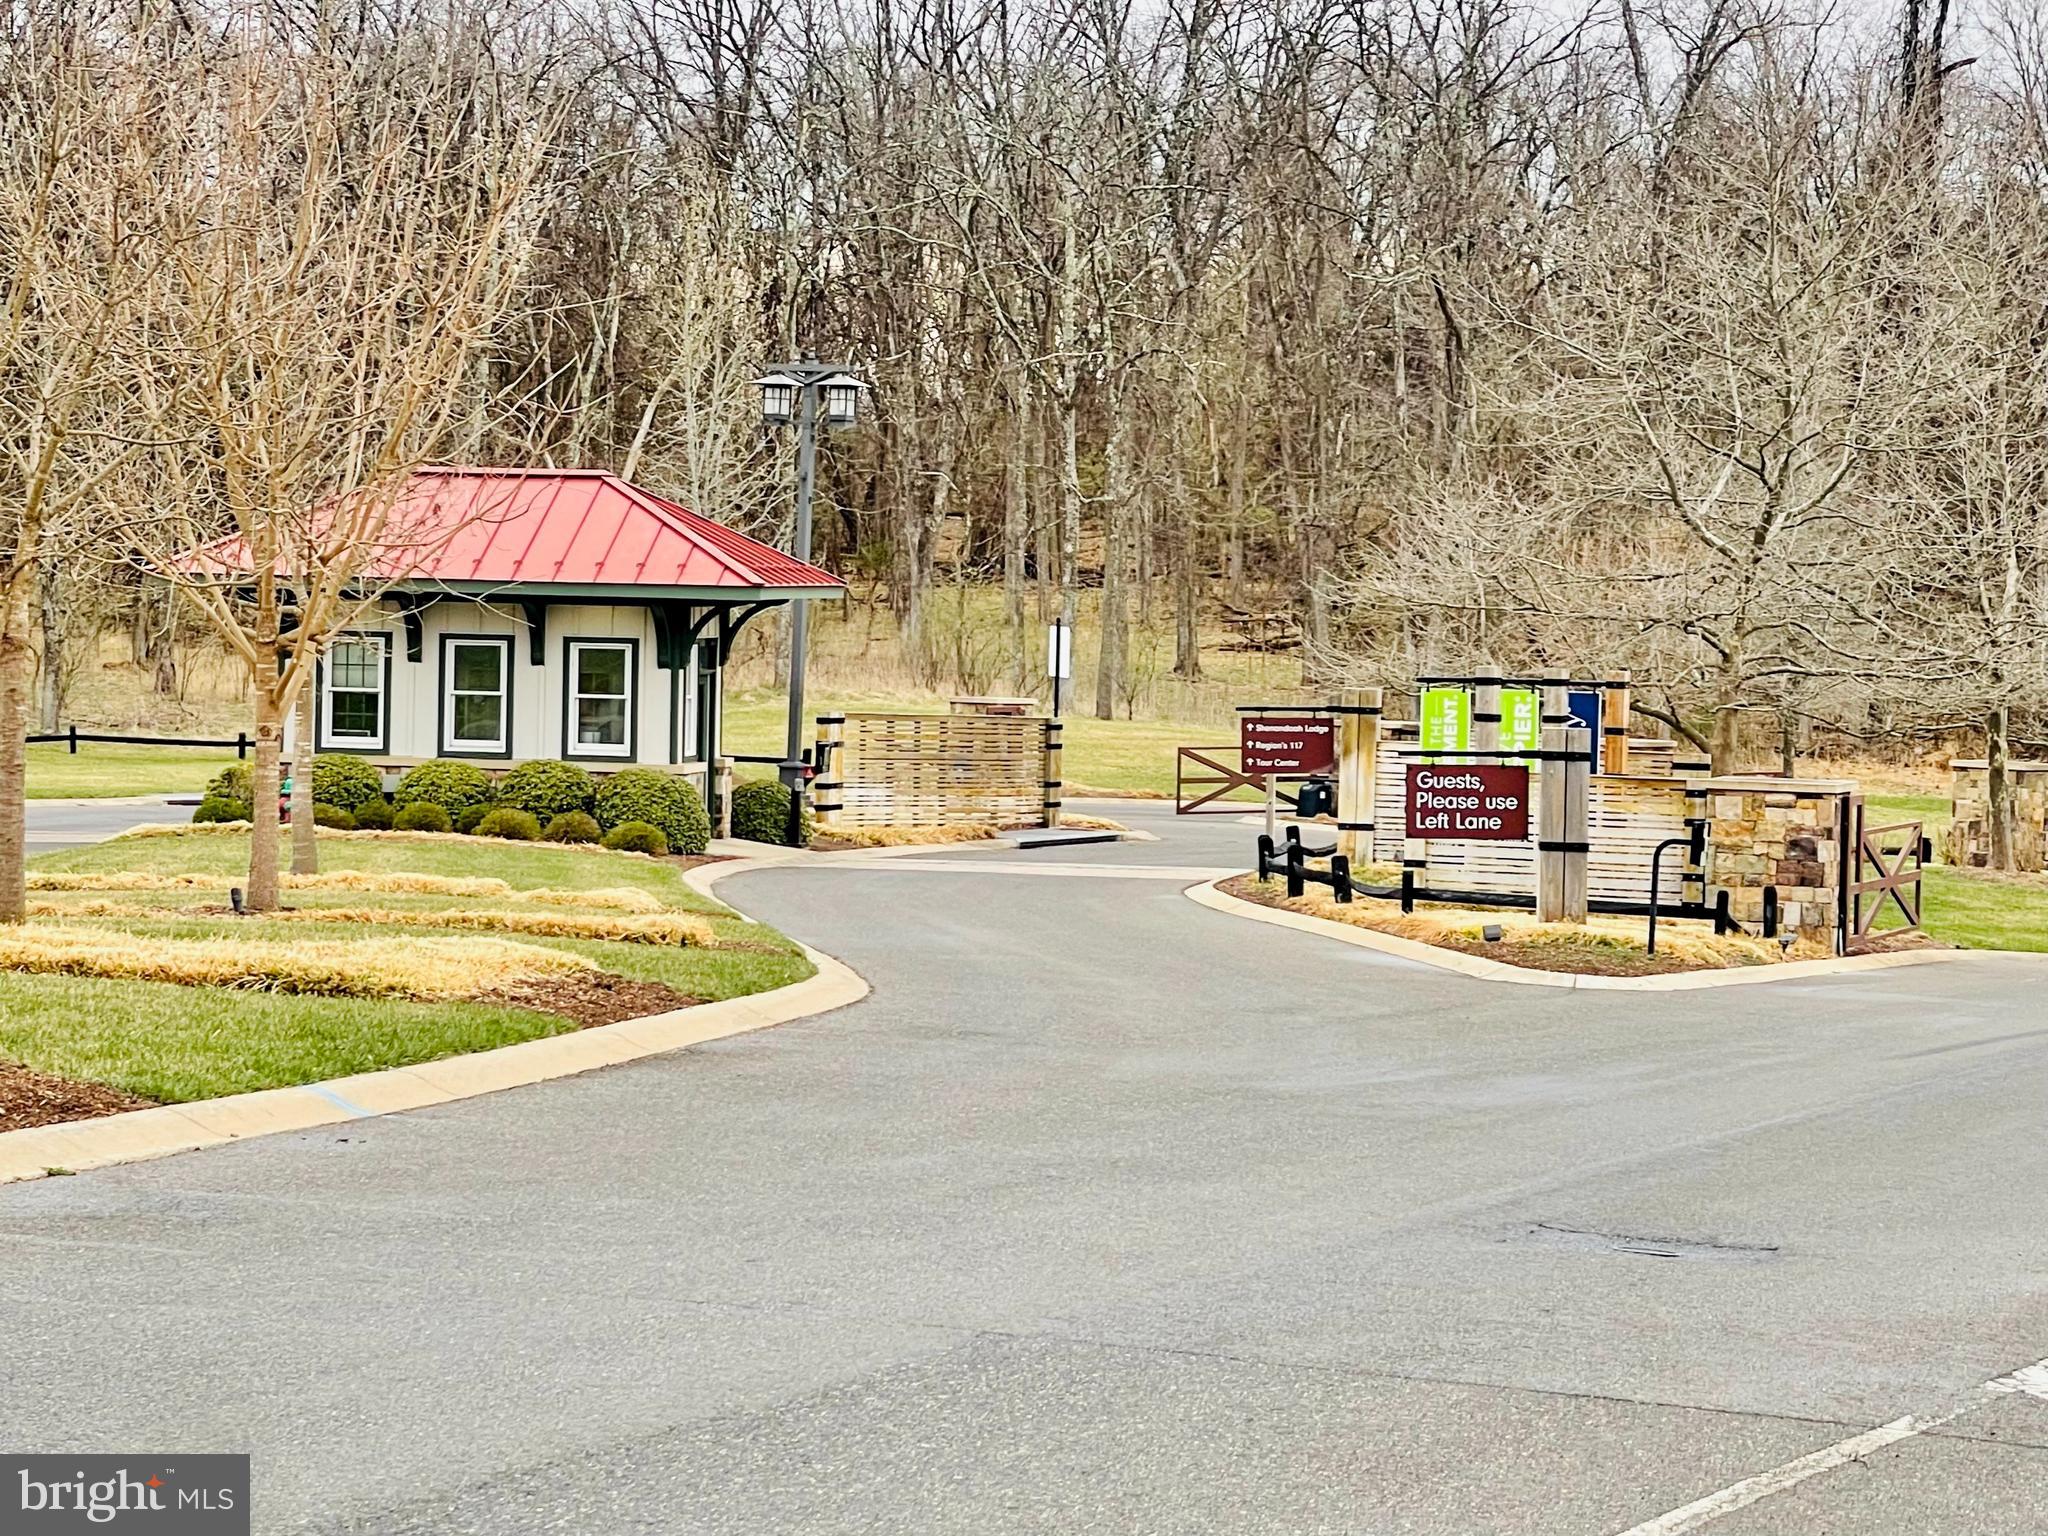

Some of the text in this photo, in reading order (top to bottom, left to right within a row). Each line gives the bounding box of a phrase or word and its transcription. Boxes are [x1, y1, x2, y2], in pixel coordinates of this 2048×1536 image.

[1304, 724, 1329, 734] Lodge
[1430, 716, 1443, 745] THE
[1289, 741, 1304, 749] 117
[1255, 758, 1300, 767] Tour Center
[1416, 771, 1485, 793] Guests,
[1416, 791, 1518, 810] Please use
[1415, 811, 1502, 830] Left Lane
